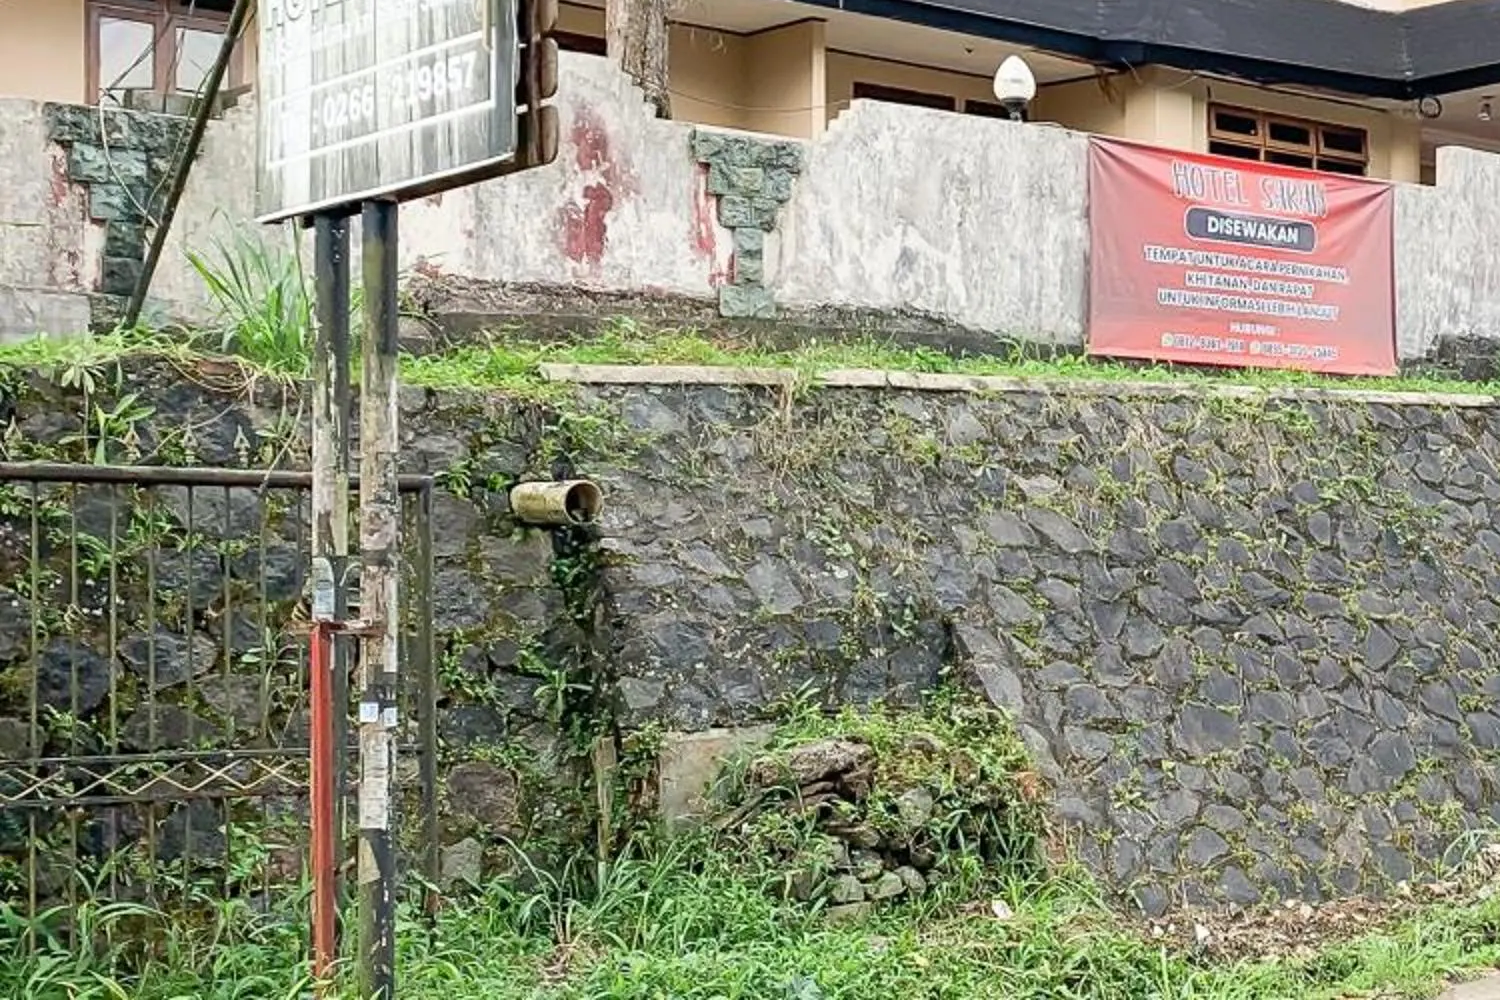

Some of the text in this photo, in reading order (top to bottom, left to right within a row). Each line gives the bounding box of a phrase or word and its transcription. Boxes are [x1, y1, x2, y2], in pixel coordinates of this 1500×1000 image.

[1172, 160, 1249, 205] HOTEL
[1206, 215, 1299, 244] DISEWAKAN
[1145, 247, 1195, 265] TEMPAT
[1197, 252, 1237, 269] UNTUK
[1159, 290, 1198, 306] UNTUK
